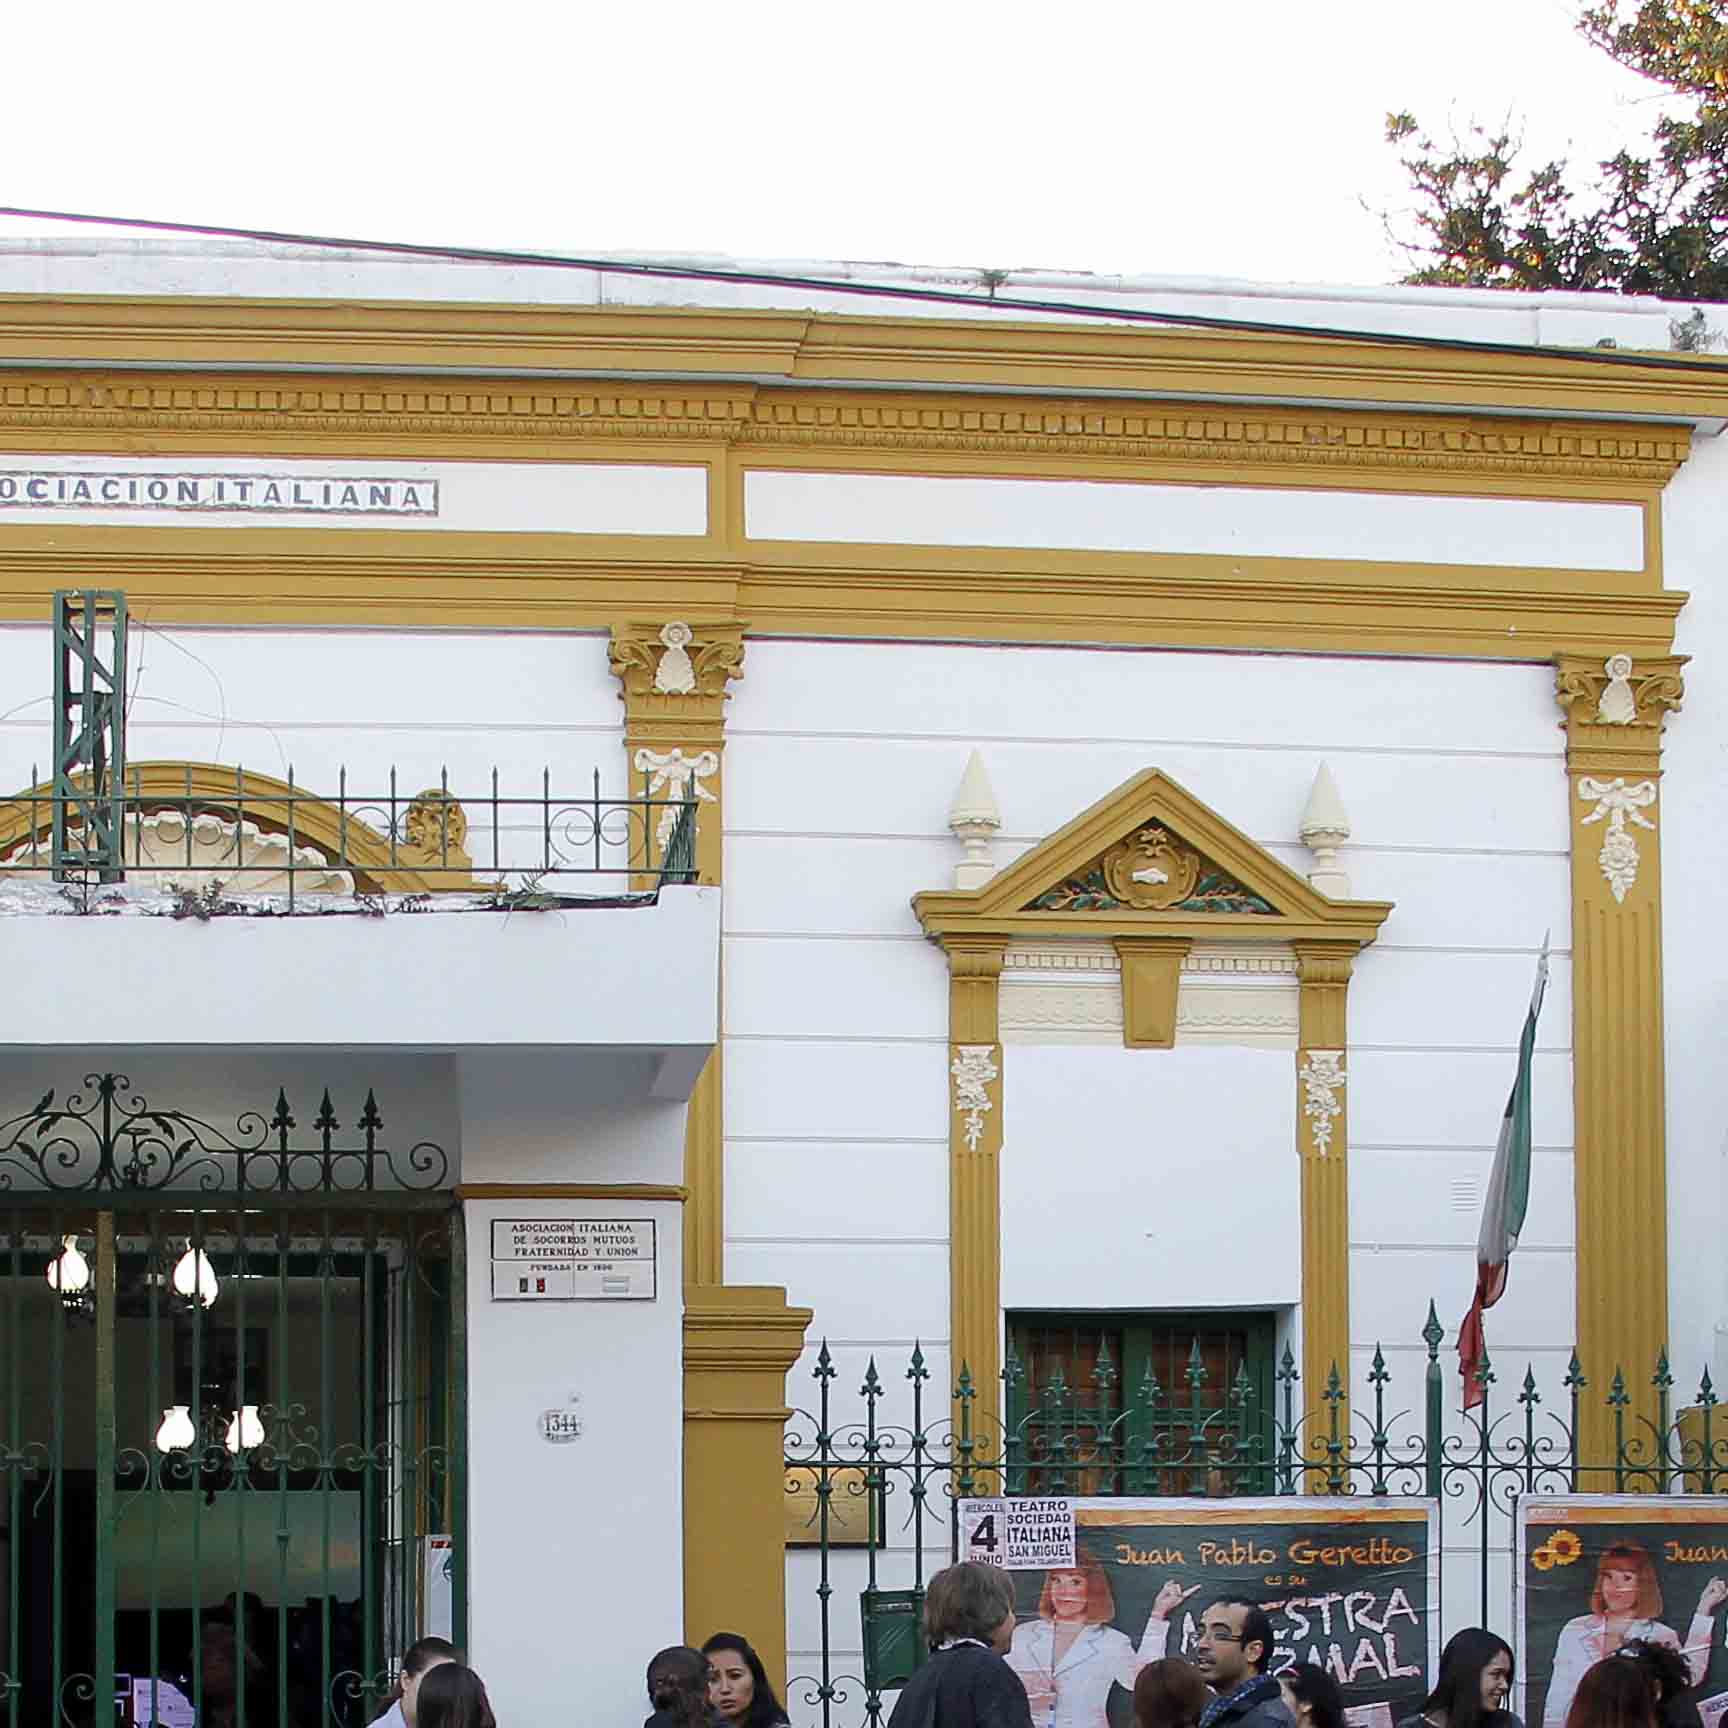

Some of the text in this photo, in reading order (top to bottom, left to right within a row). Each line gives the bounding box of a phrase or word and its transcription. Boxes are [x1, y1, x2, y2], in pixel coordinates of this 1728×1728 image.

[216, 480, 421, 507] ITALIANA
[512, 1223, 633, 1233] ASOCIACION ITALIANA
[513, 1235, 636, 1245] DE SOCORROS MUTUOS
[515, 1247, 639, 1257] FRATERNIDAD Y UNION
[545, 1414, 577, 1432] 1344
[1009, 1500, 1068, 1512] TEATRO
[1007, 1513, 1071, 1524] SOCIEDAD
[971, 1515, 998, 1552] 4
[1007, 1526, 1071, 1543] ITALIANA
[1008, 1544, 1071, 1557] SAN MIGUEL
[1116, 1537, 1415, 1567] Juan Pablo Geretto
[1664, 1539, 1728, 1563] Juan
[1263, 1574, 1308, 1586] es su
